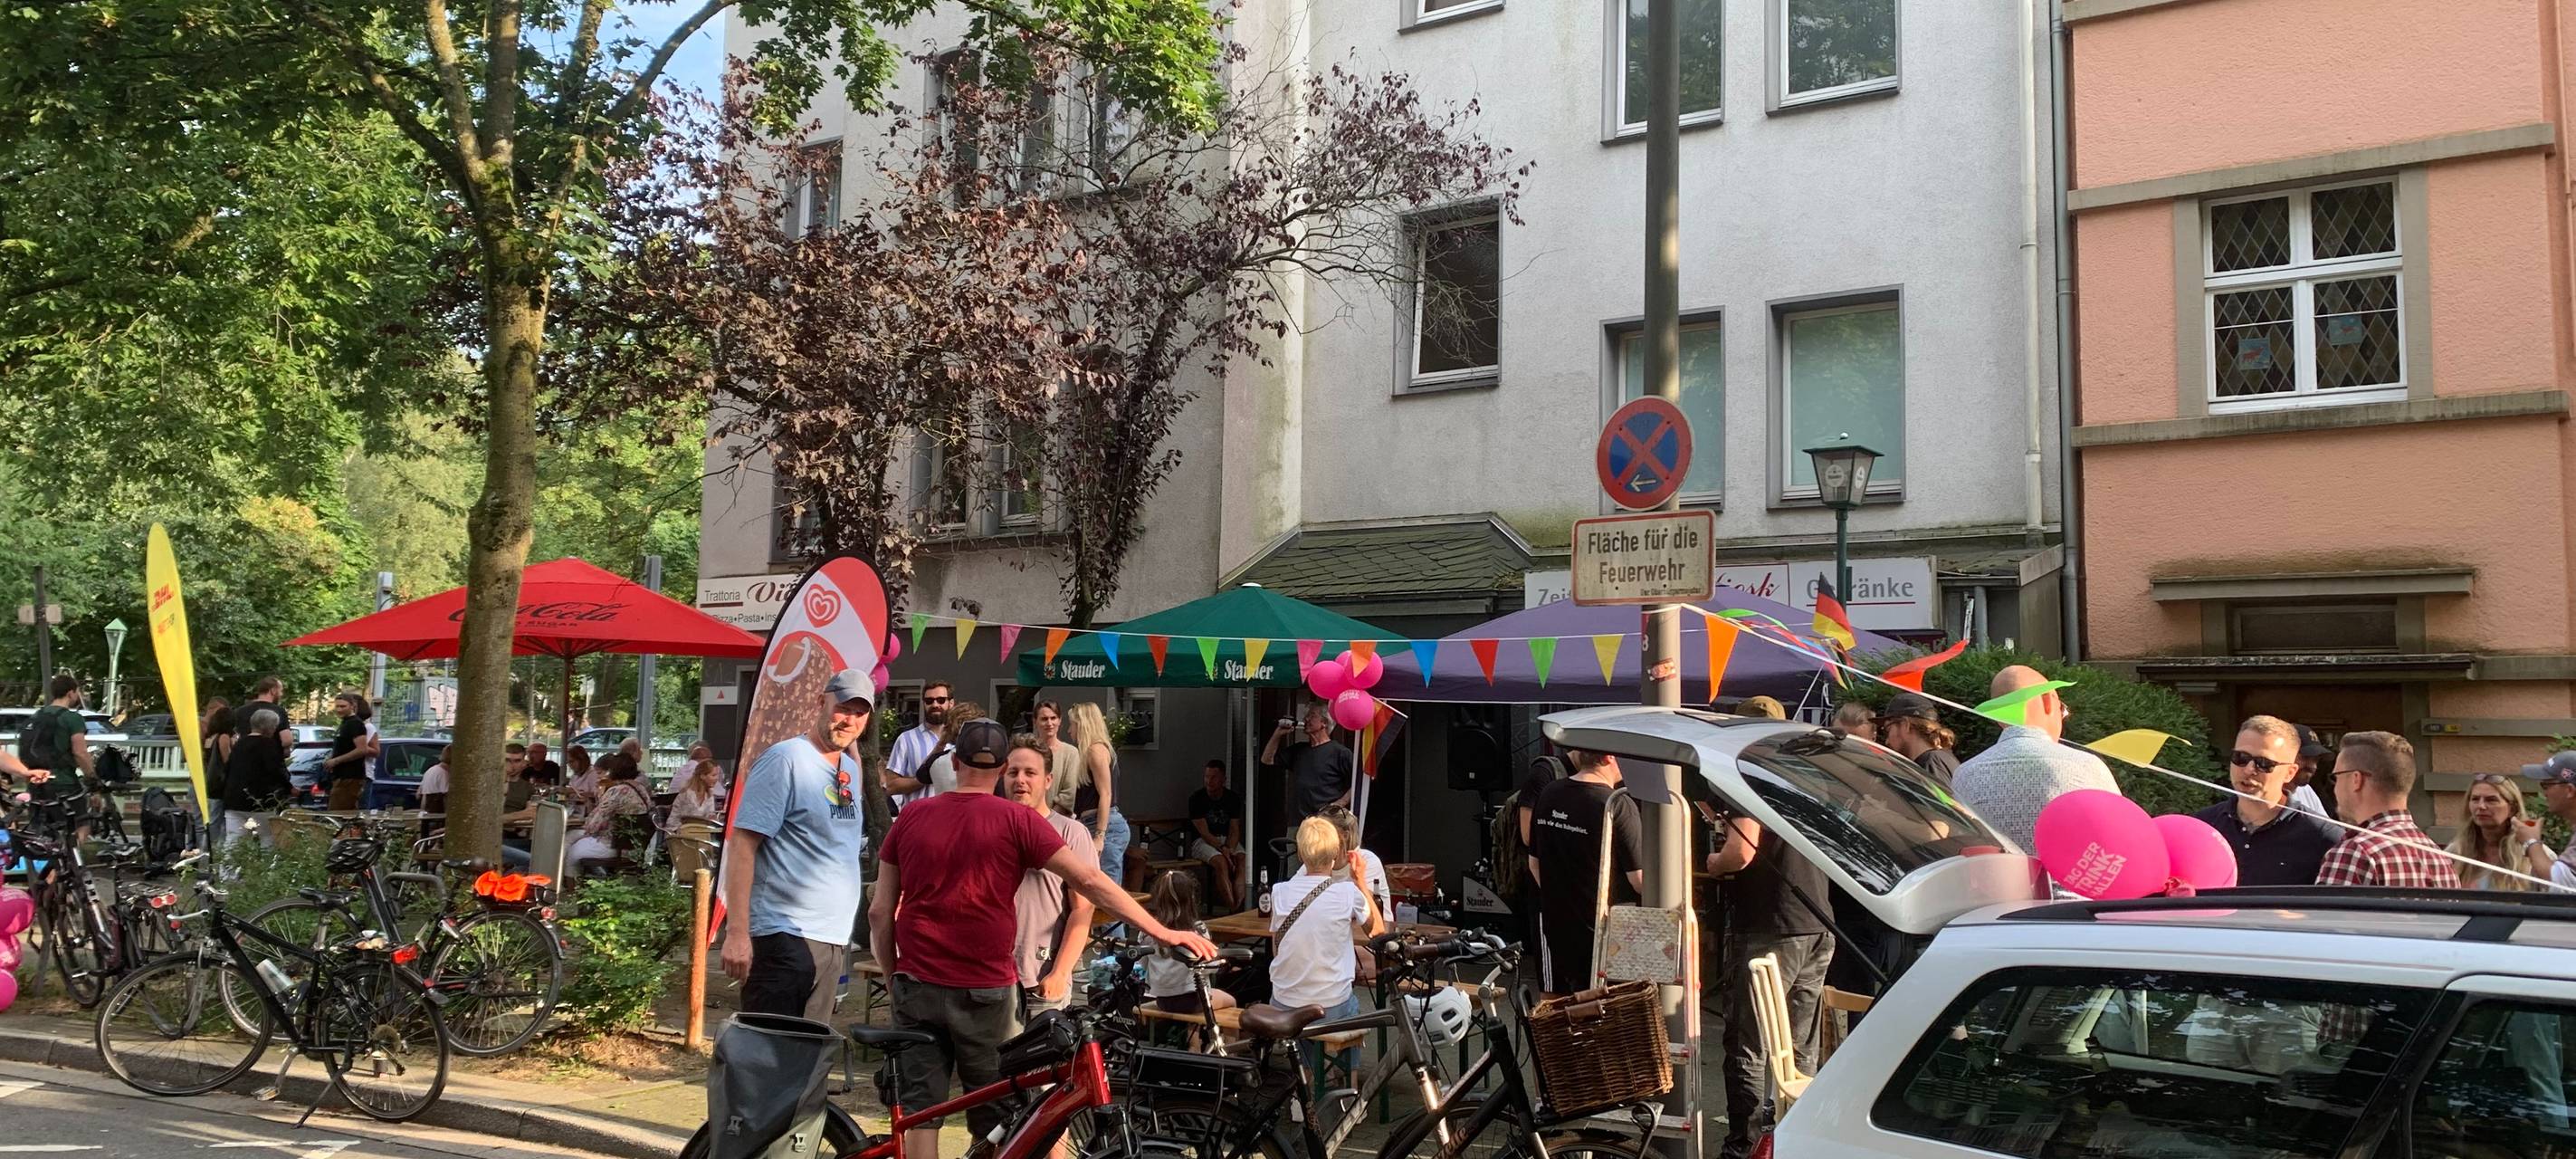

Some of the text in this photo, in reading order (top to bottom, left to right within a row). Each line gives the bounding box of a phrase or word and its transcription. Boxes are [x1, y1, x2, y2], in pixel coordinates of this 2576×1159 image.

[1588, 525, 1698, 554] Fläche für die
[1599, 558, 1685, 584] Feuerwehr
[705, 590, 740, 601] Trattoria
[1060, 659, 1106, 681] Stauder
[2063, 841, 2102, 886] TAG DER
[2075, 847, 2115, 893] TRINK
